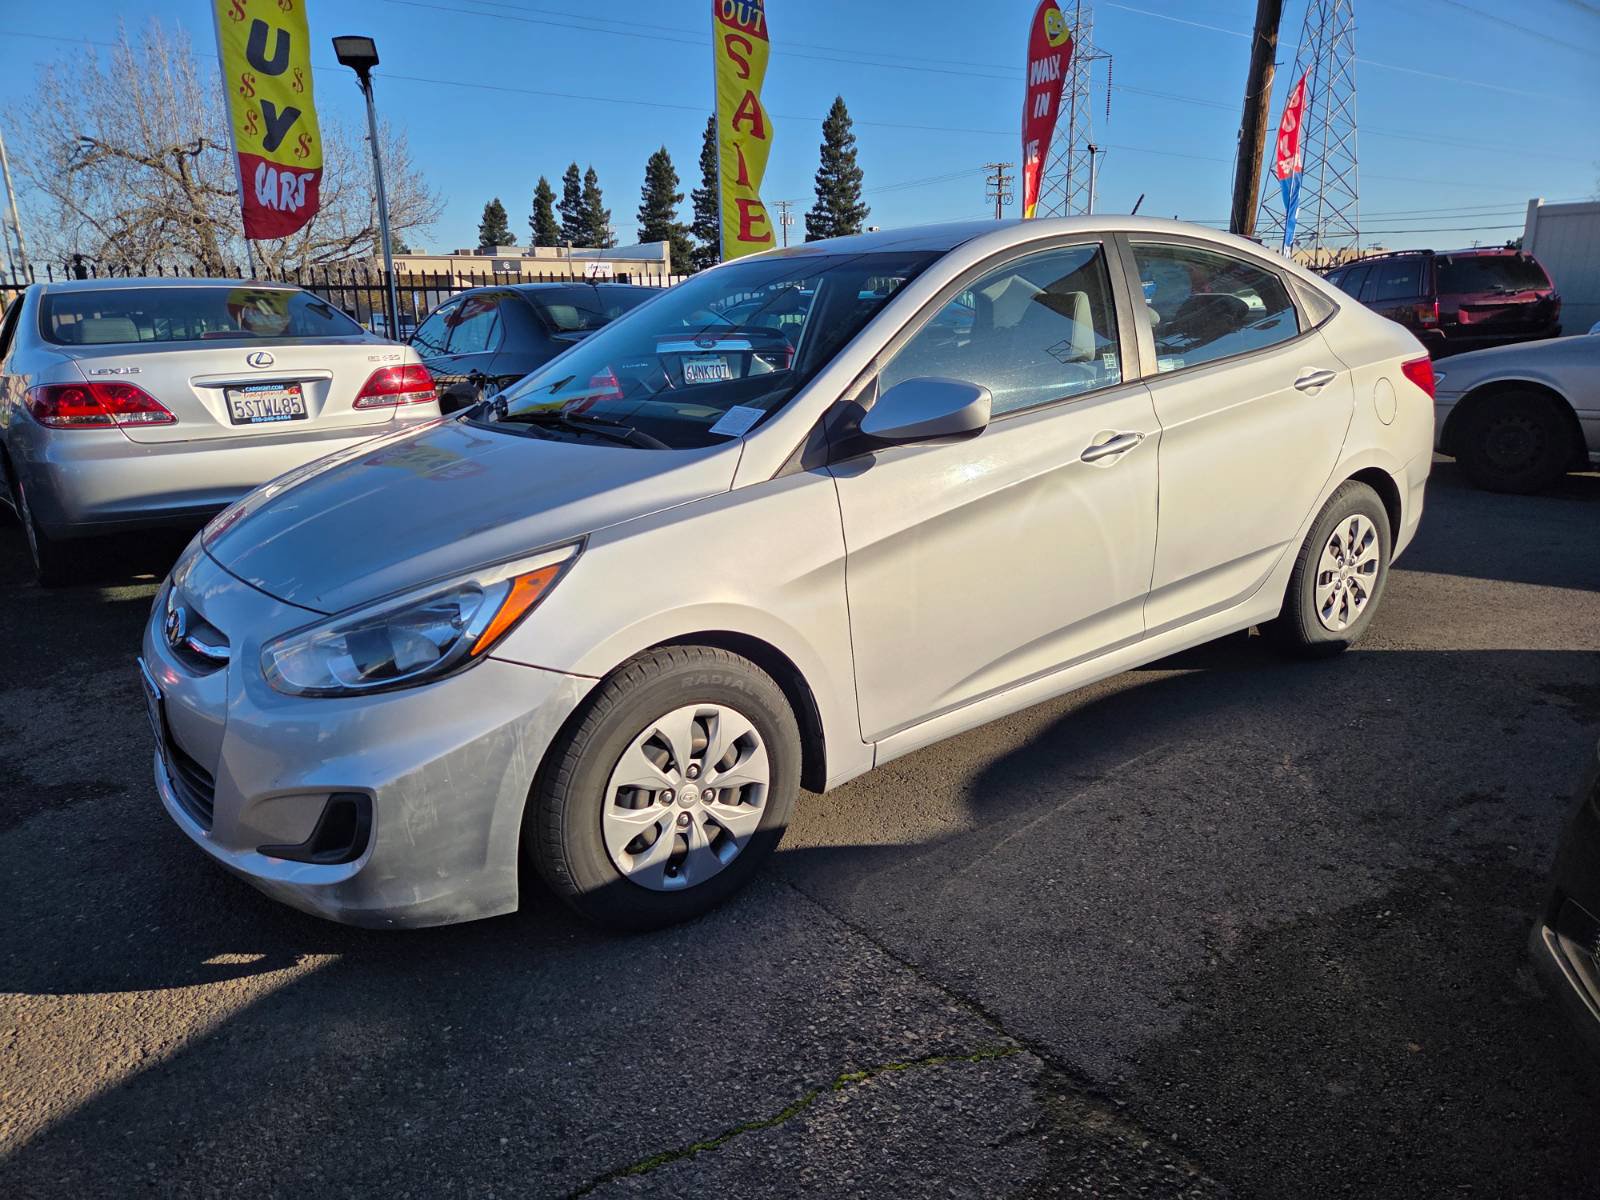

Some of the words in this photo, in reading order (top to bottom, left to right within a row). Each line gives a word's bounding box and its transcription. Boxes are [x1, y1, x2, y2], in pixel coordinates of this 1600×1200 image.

[722, 0, 764, 32] OUT
[1030, 54, 1061, 87] WALK
[1034, 92, 1051, 119] IN
[255, 161, 315, 213] CARS
[89, 366, 142, 376] LEXUS
[234, 397, 301, 418] 5STW485
